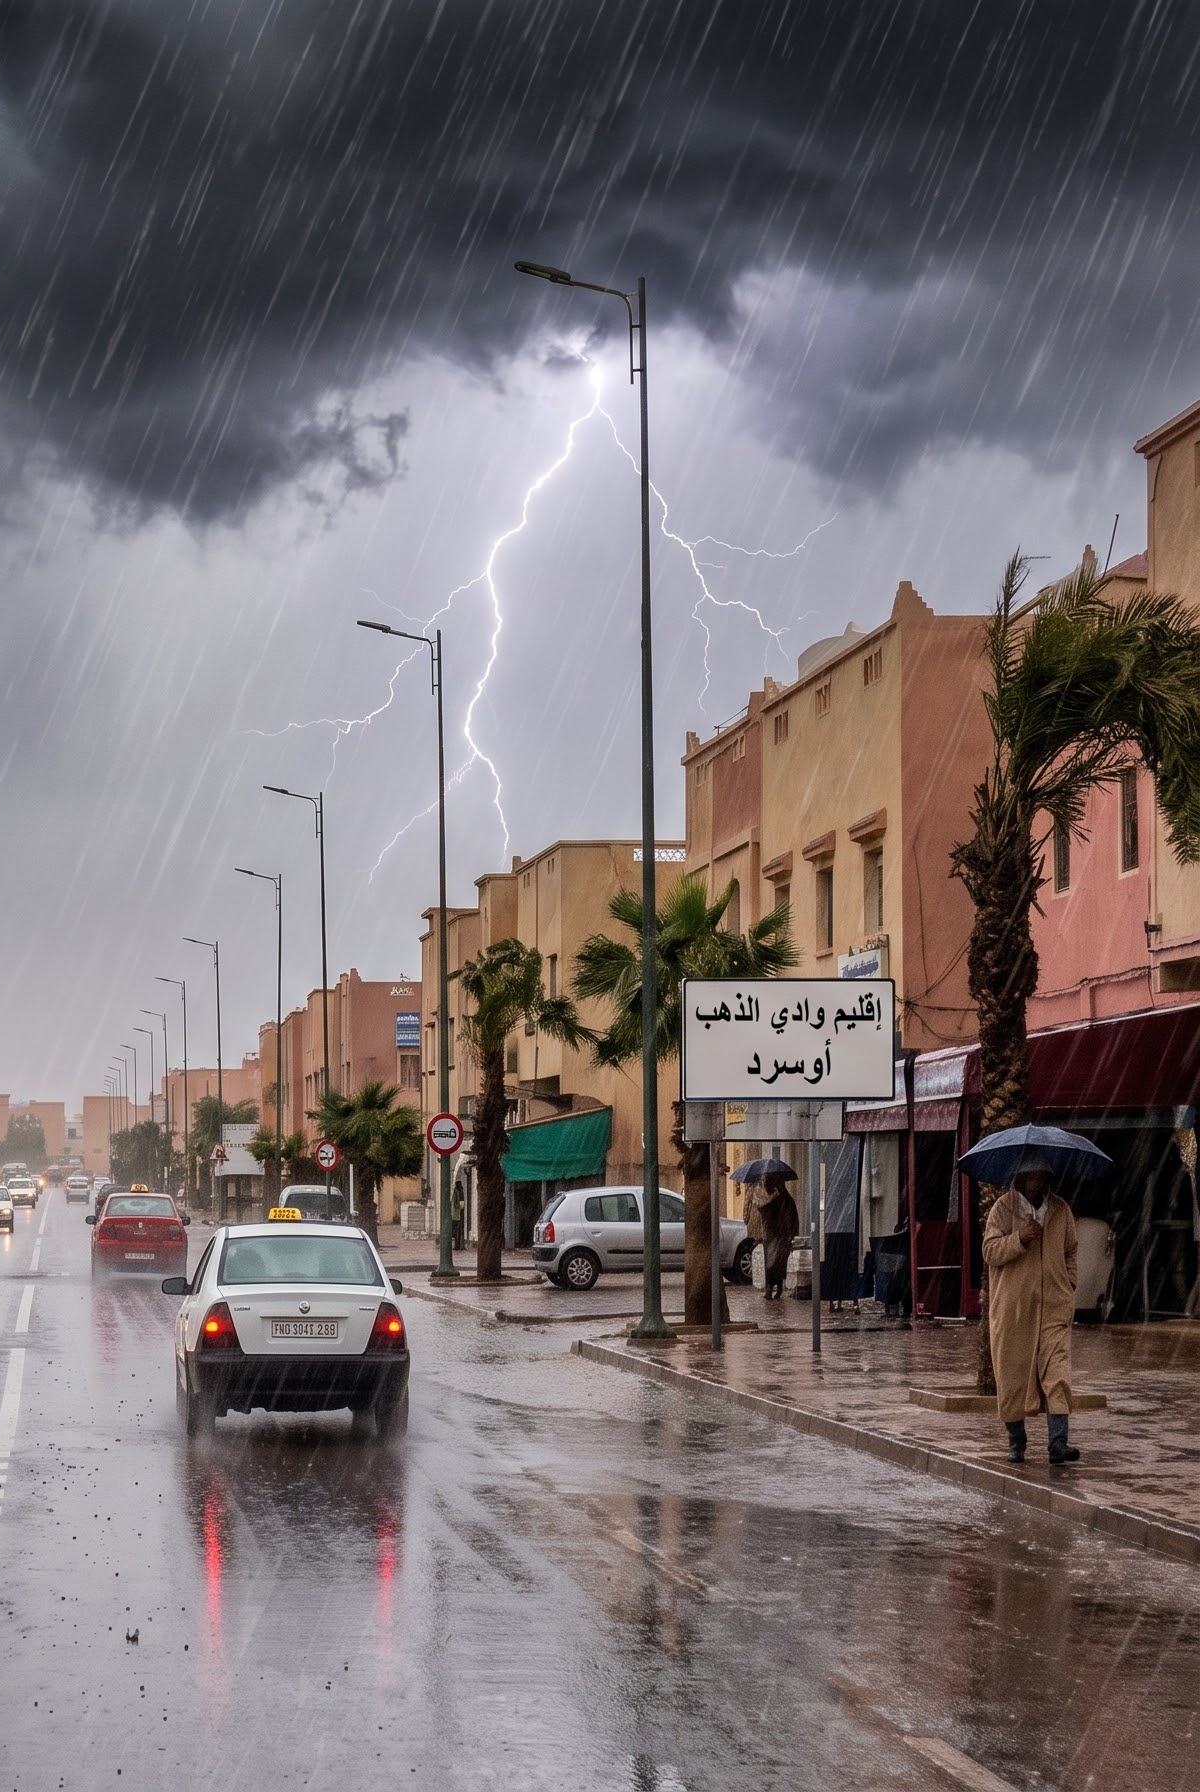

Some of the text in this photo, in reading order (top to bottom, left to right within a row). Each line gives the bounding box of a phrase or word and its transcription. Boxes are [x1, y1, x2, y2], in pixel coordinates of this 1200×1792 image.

[695, 992, 882, 1035] إقليم وادي الذهب
[747, 1038, 832, 1085] أوسرد
